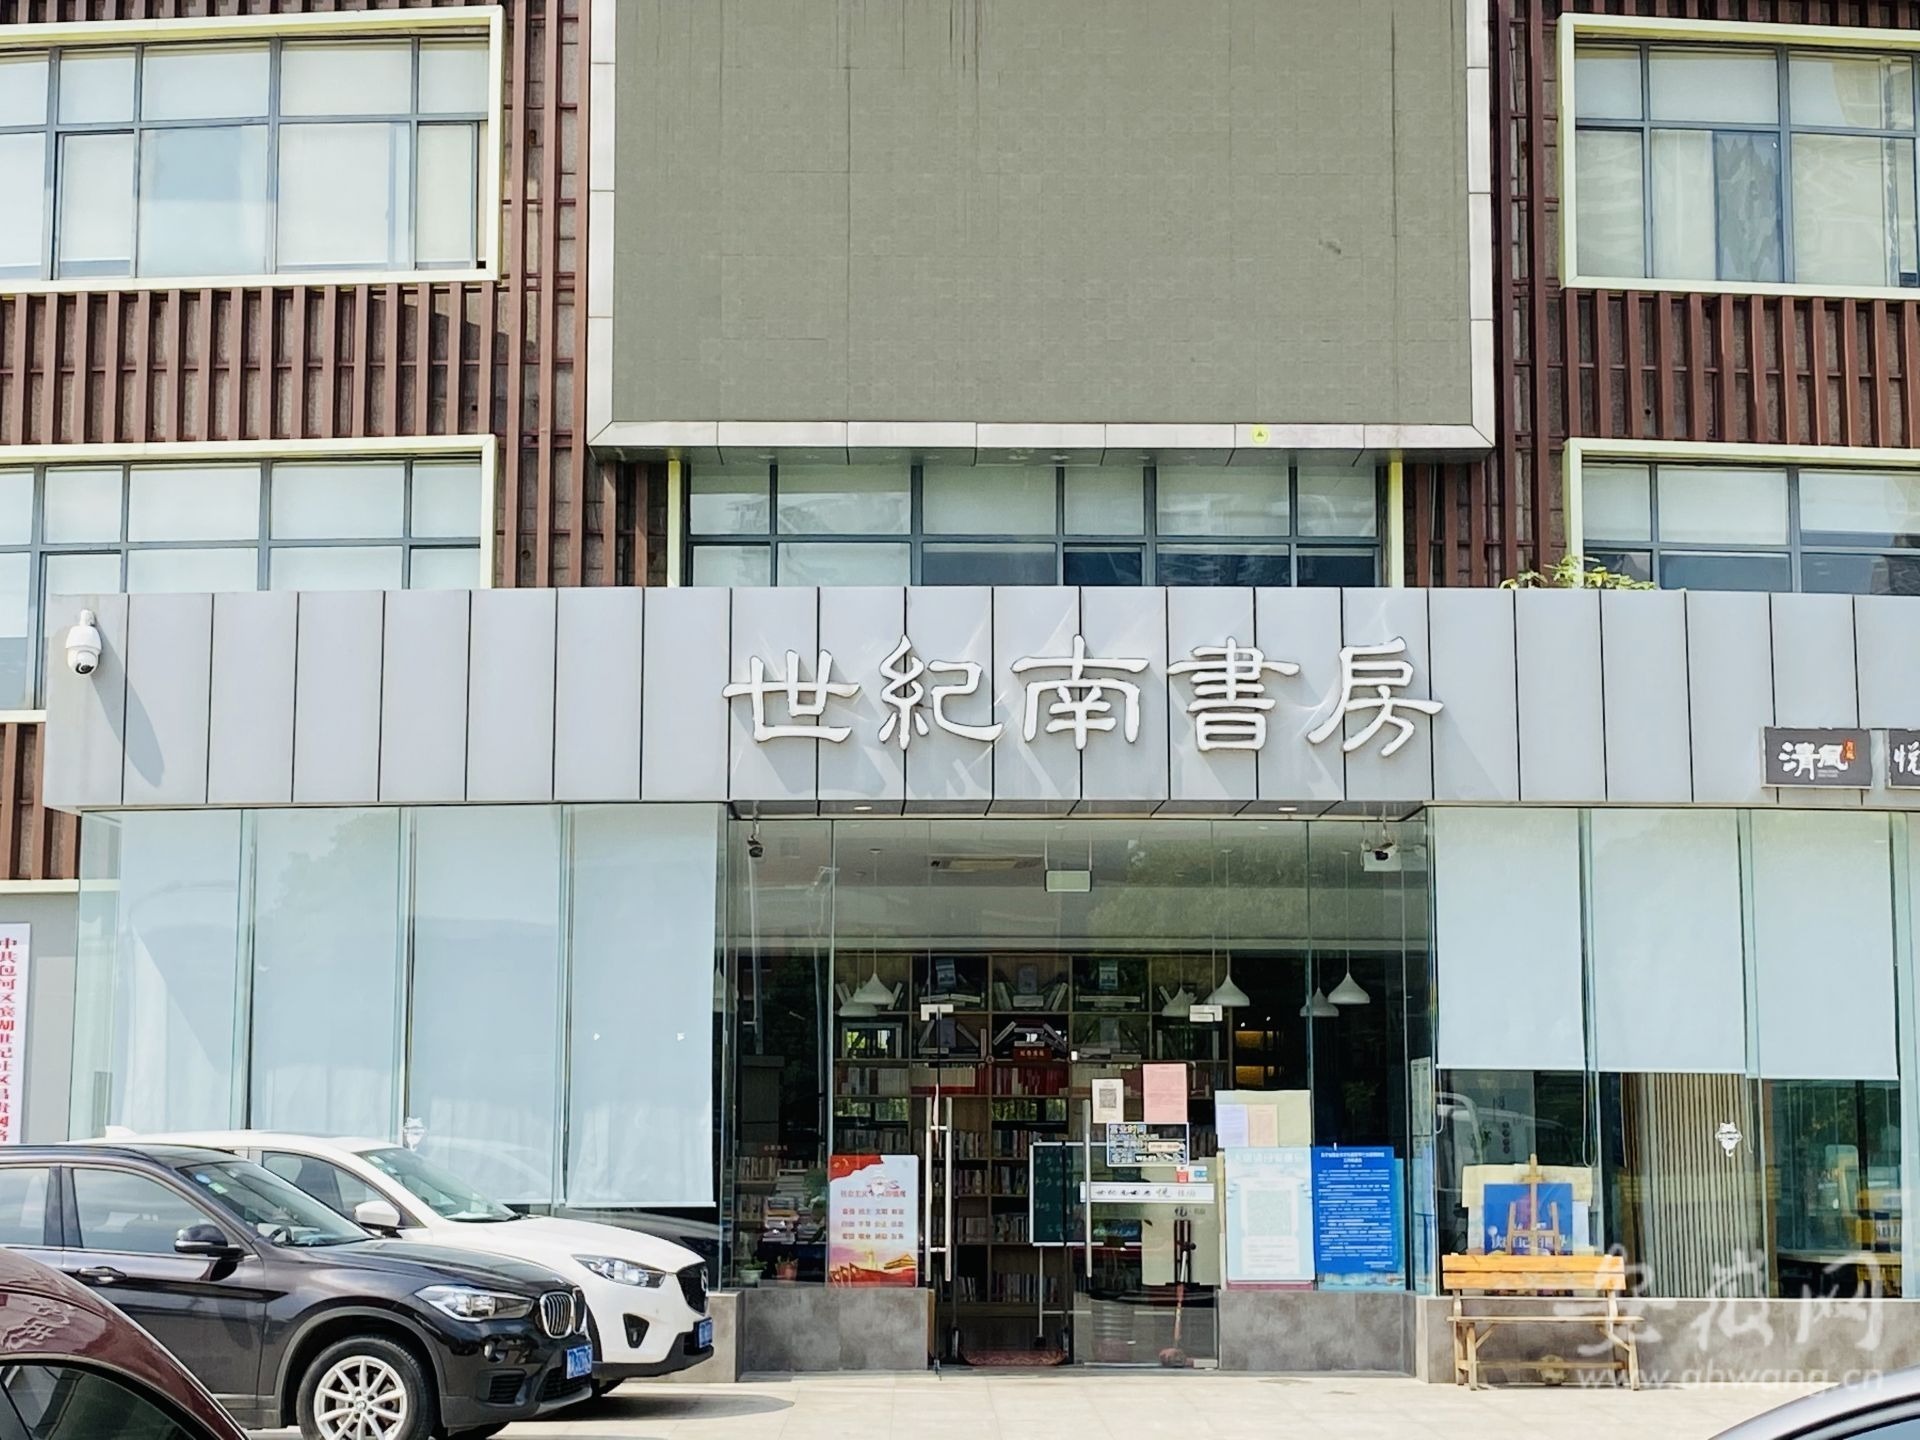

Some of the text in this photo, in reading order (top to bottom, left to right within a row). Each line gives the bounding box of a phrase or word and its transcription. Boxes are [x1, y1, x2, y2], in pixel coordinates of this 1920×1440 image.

[723, 635, 1444, 758] 世紀南書房
[840, 1189, 906, 1198] 社会主义价值观
